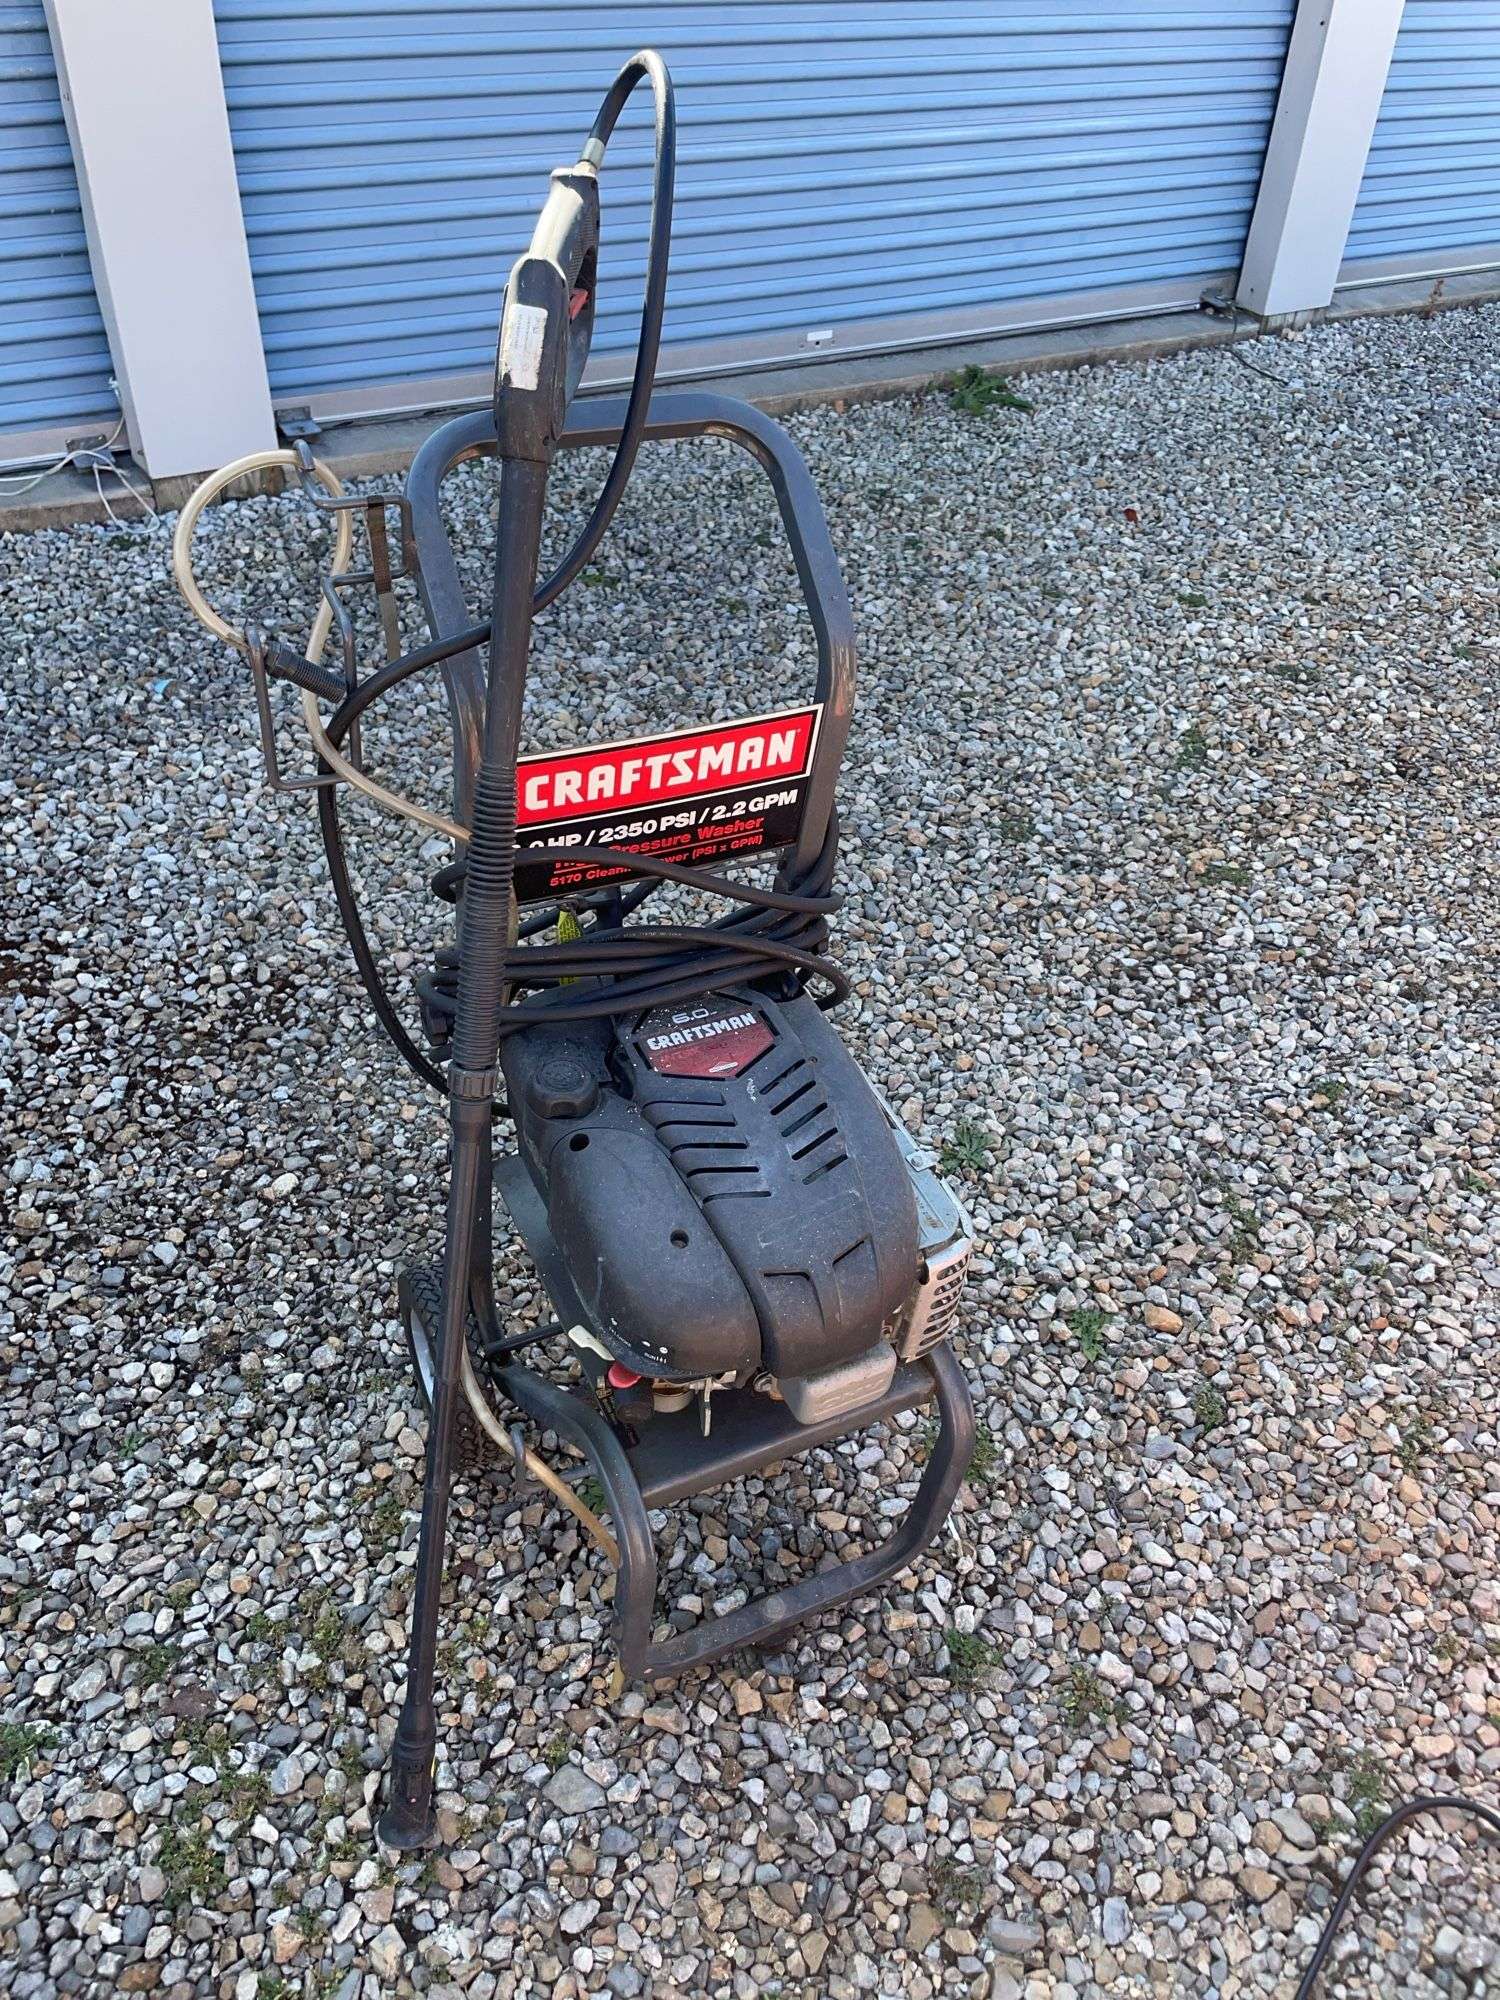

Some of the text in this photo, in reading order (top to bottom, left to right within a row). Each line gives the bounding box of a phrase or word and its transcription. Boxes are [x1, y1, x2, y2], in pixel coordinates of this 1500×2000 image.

[524, 729, 797, 811] CRAFTSMAN
[599, 819, 657, 844] 2350
[659, 810, 696, 832] PSI
[712, 801, 746, 821] 2.2
[748, 789, 799, 813] GPM
[698, 816, 765, 840] Washer
[549, 873, 582, 887] 5170
[692, 845, 717, 861] (PSI
[730, 834, 764, 849] GPM)
[646, 1012, 757, 1050] CRAFTSMAN
[672, 1008, 709, 1024] 6.0
